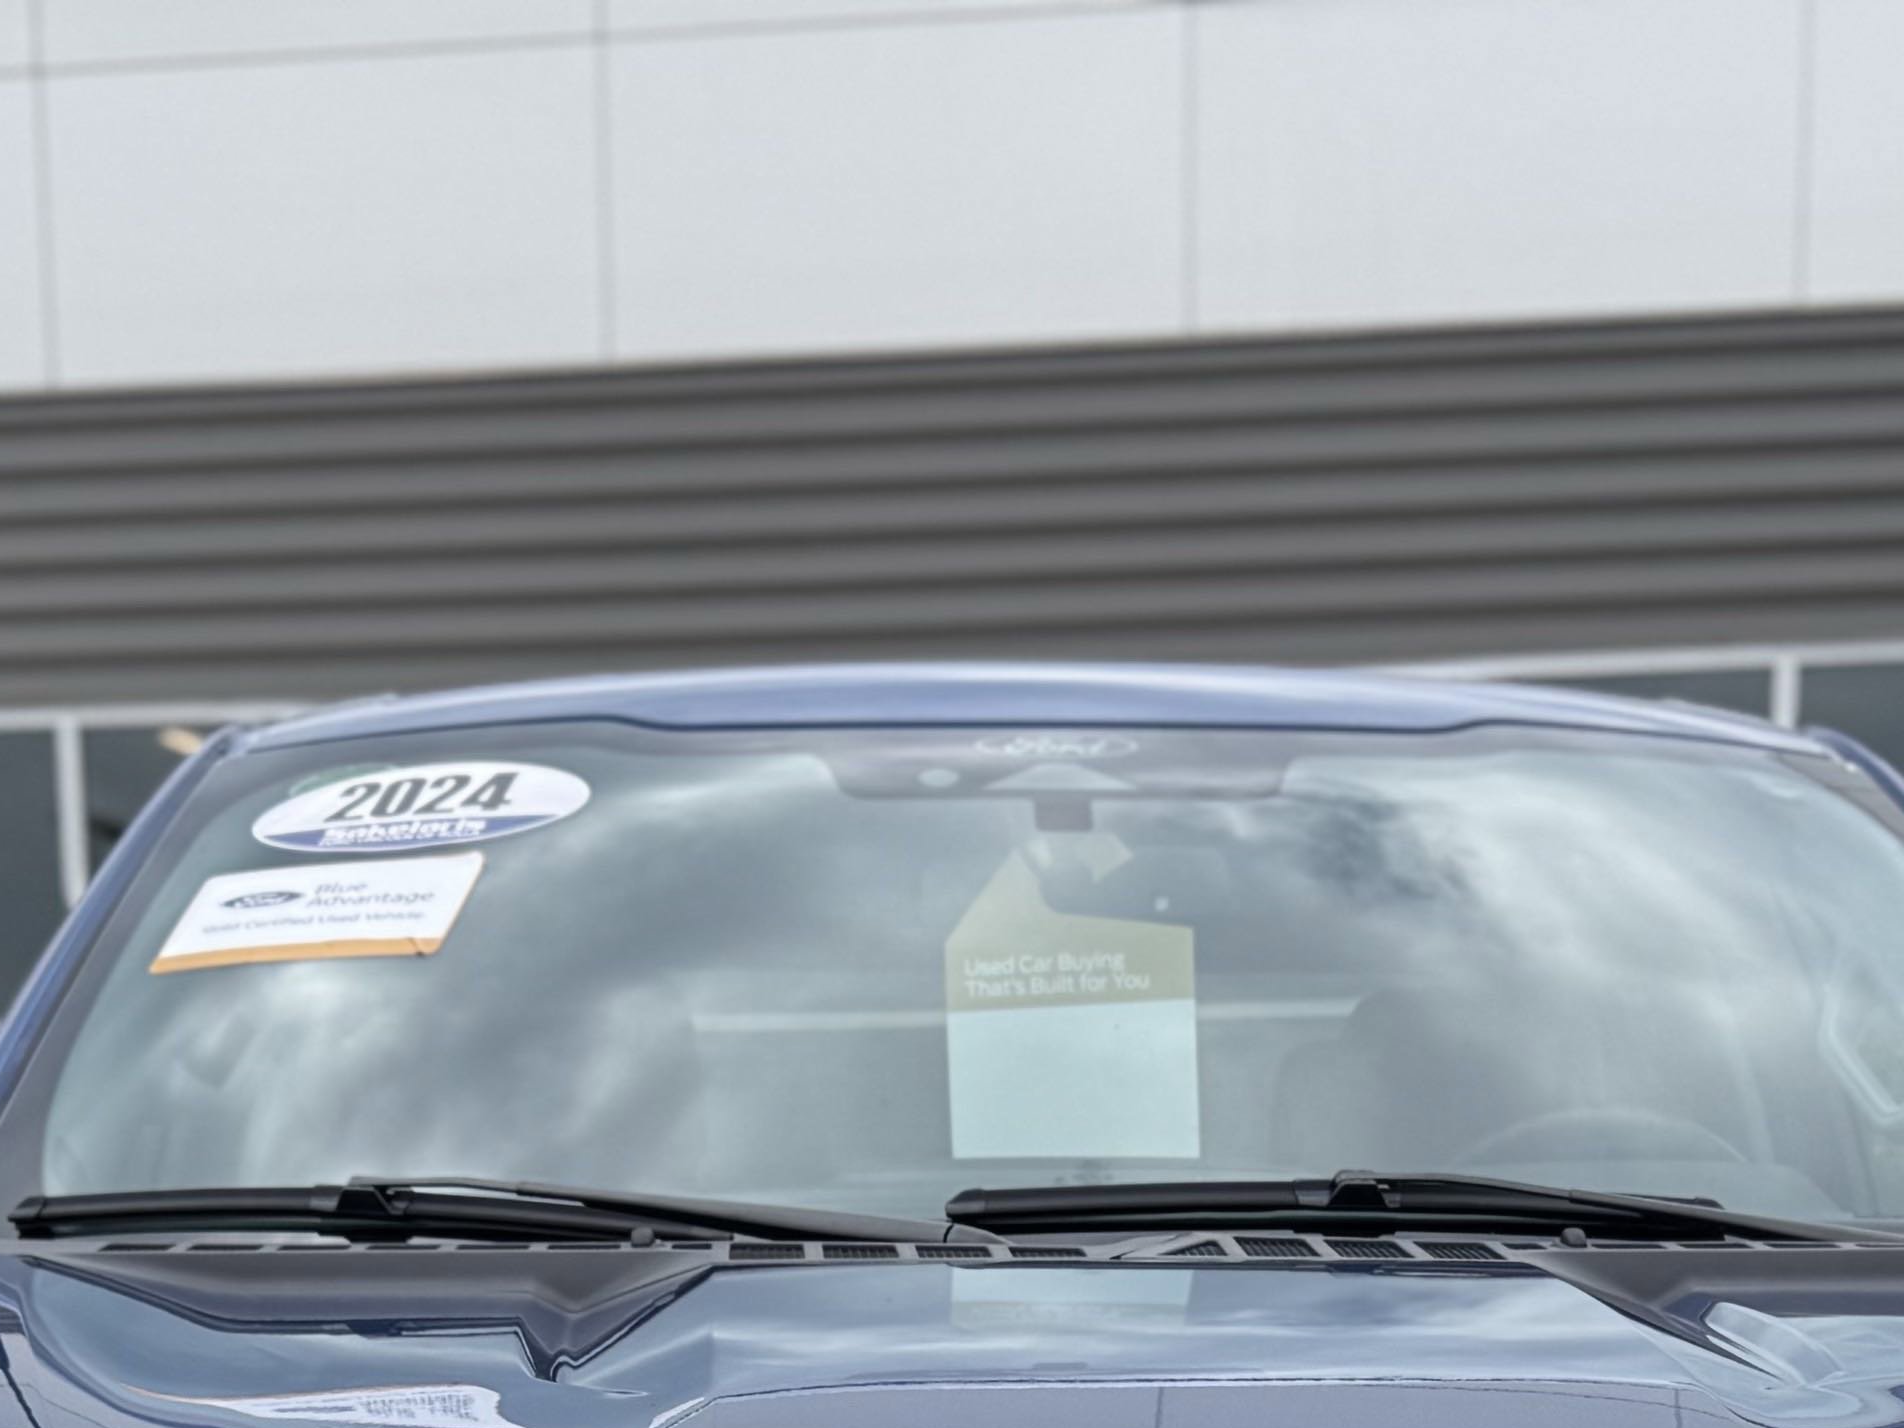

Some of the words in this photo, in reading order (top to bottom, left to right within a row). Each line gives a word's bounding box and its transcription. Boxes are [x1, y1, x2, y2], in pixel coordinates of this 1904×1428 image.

[323, 772, 520, 823] 2024
[304, 889, 435, 909] Advantage
[313, 881, 368, 895] Blue
[964, 955, 1015, 977] Used
[1018, 954, 1054, 974] Car
[1057, 951, 1126, 977] Buying
[964, 977, 1026, 998] That's
[1031, 975, 1074, 995] Built
[1079, 974, 1108, 993] for
[1111, 973, 1151, 991] You
